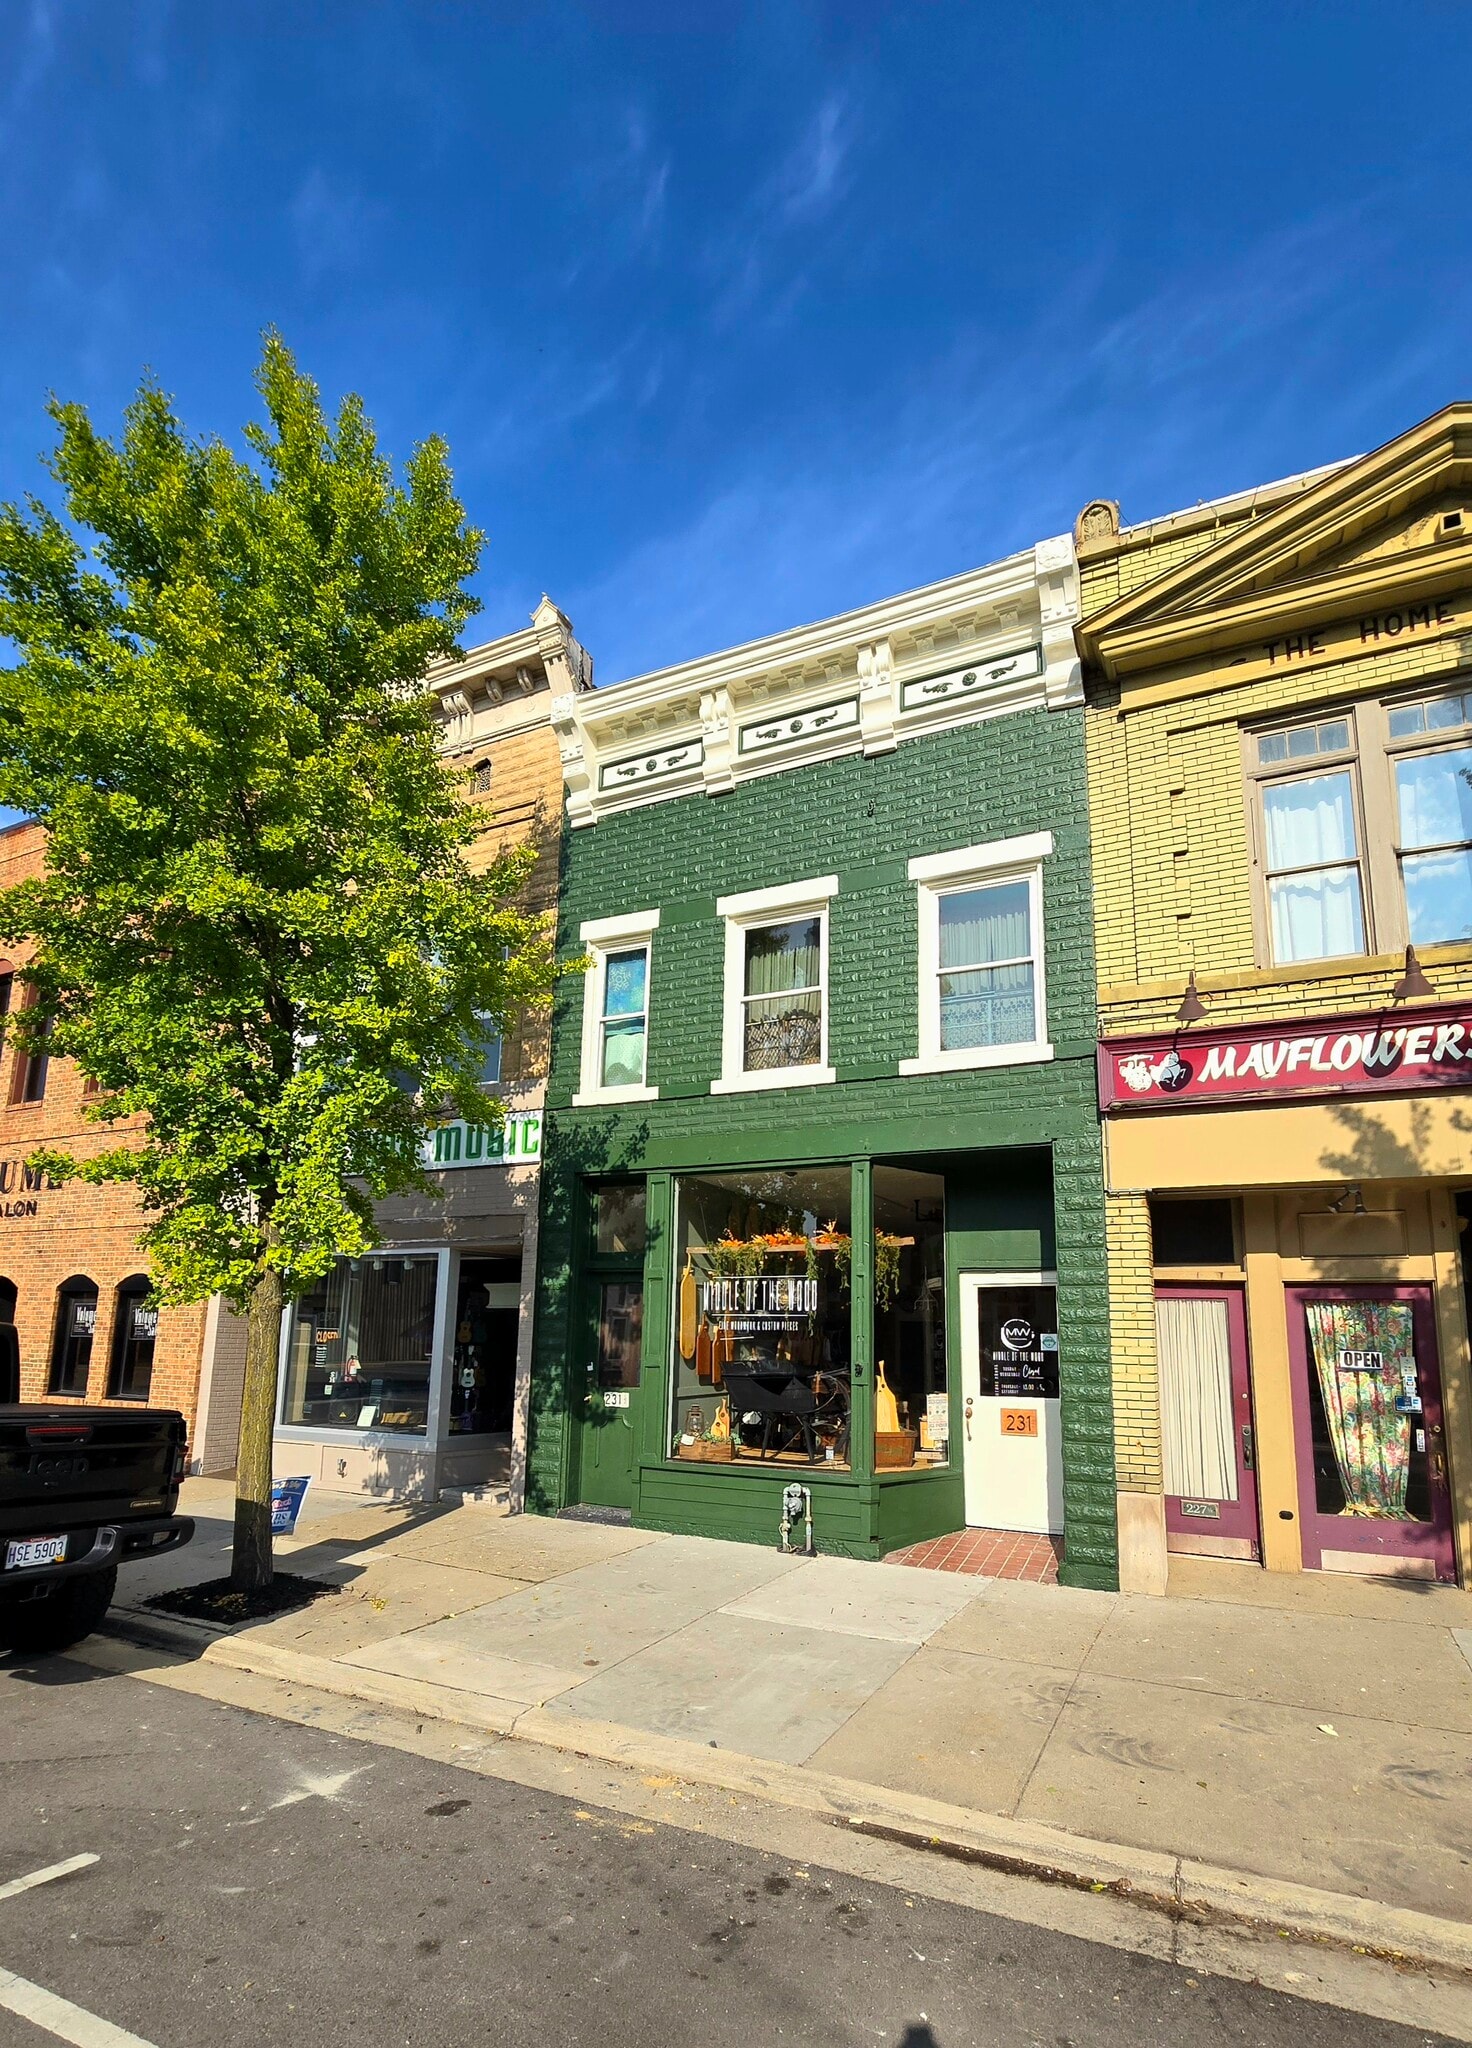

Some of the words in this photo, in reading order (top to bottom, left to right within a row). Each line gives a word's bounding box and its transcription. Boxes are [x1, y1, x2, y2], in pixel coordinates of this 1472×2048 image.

[1263, 630, 1326, 666] THE
[1360, 599, 1455, 644] HOME
[1197, 1023, 1472, 1083] MAYFLOWER
[0, 1200, 38, 1218] LON
[703, 1280, 740, 1311] MIDDLE
[745, 1280, 758, 1311] OF
[762, 1280, 781, 1311] THE
[788, 1280, 818, 1311] WOOD
[781, 1321, 799, 1331] PIECES
[1005, 1328, 1031, 1338] MW
[1344, 1351, 1381, 1368] OPEN
[605, 1393, 621, 1405] 231
[1006, 1414, 1032, 1432] 231
[27, 1454, 89, 1480] Jeep
[7, 1545, 31, 1564] HSE
[34, 1541, 63, 1559] 5903
